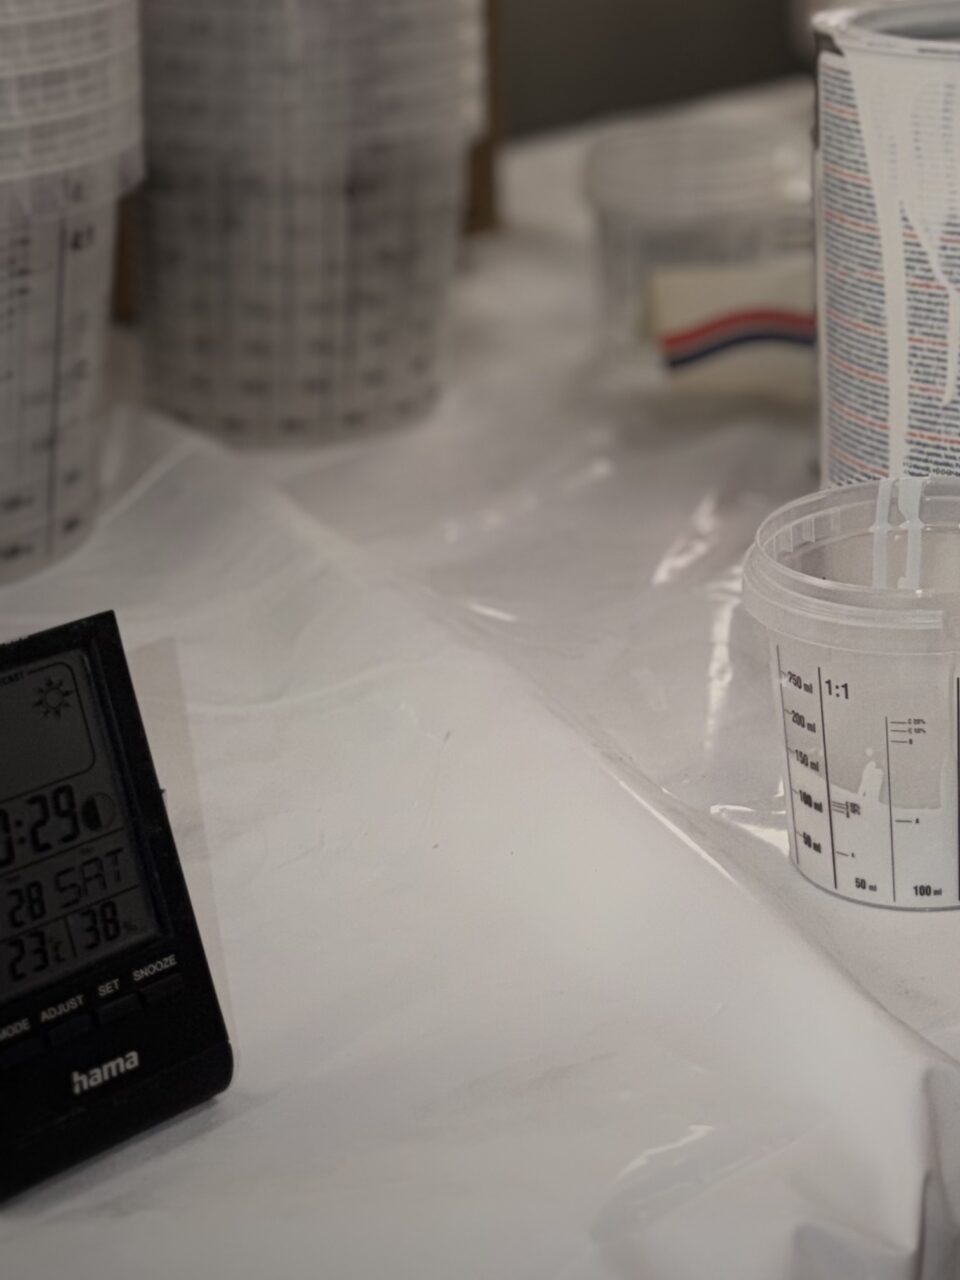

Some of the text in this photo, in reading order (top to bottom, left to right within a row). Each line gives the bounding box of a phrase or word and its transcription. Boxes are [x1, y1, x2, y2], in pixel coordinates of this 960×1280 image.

[825, 679, 849, 699] 1:1
[4, 846, 125, 929] 28 SAT
[855, 877, 866, 890] 50
[913, 885, 932, 897] 100
[40, 994, 84, 1023] ADJUST
[97, 978, 120, 998] SET
[132, 952, 177, 983] SNOOZE
[71, 1049, 140, 1095] hama
